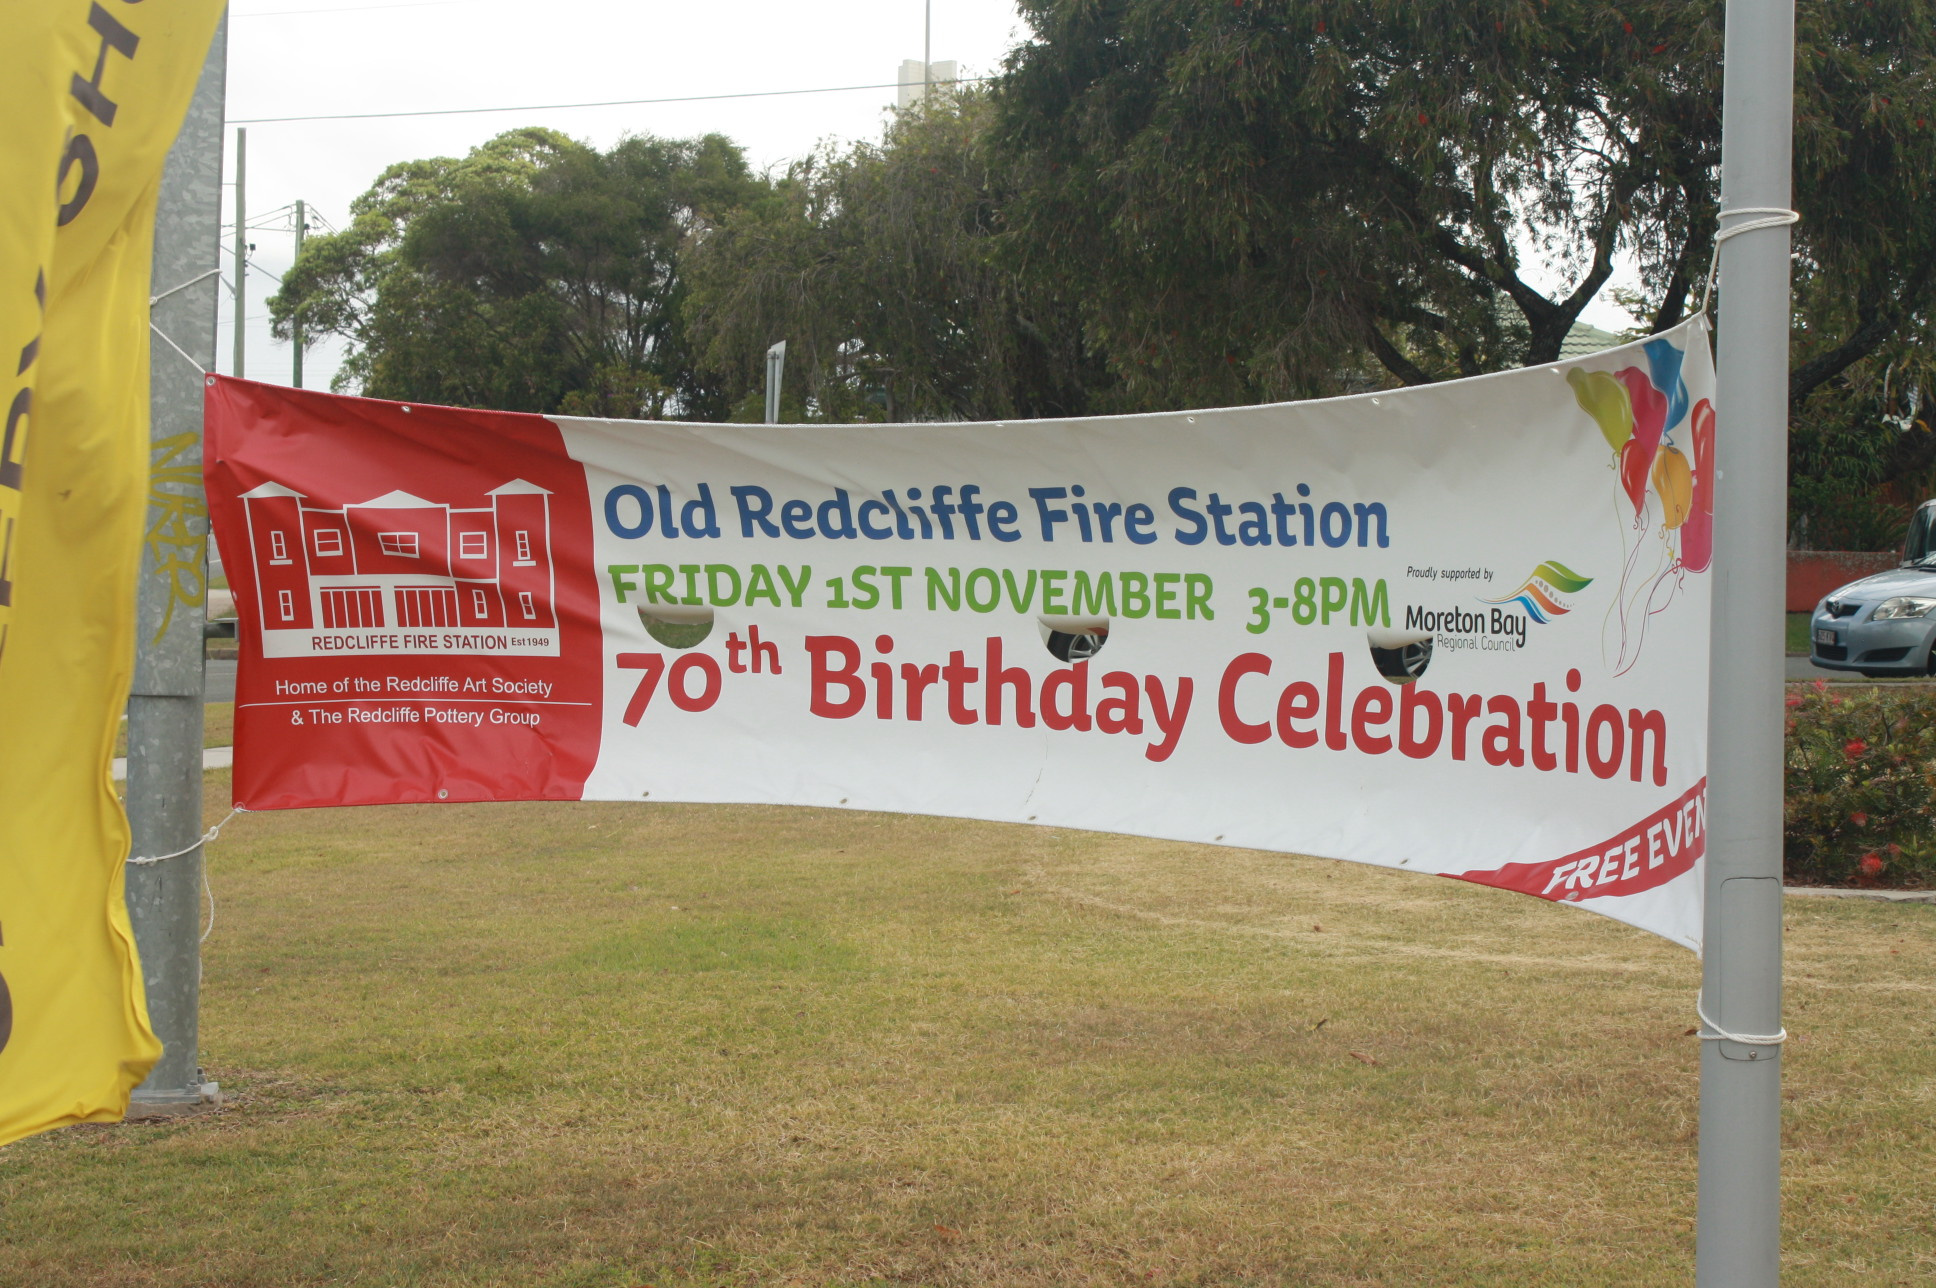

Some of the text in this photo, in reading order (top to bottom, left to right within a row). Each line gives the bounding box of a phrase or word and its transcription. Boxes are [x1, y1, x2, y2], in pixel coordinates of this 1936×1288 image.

[604, 482, 1390, 548] Old Redcliffe Fire Station
[1406, 566, 1494, 582] Proudly supported by
[607, 564, 1391, 634] FRIDAY 1ST NOVEMBER 3-8PM
[1405, 604, 1527, 648] Moreton Bay
[1437, 633, 1516, 652] Regional Council
[311, 635, 399, 651] REDCLIFFE
[403, 635, 439, 650] FIRE
[443, 635, 508, 650] STATION
[275, 676, 553, 698] Home of the Redcliffe Art Society
[291, 706, 540, 728] & The Redcliffe Pottery Group
[616, 624, 1668, 788] 70th Birthday Celebration
[1542, 835, 1640, 895] FREE
